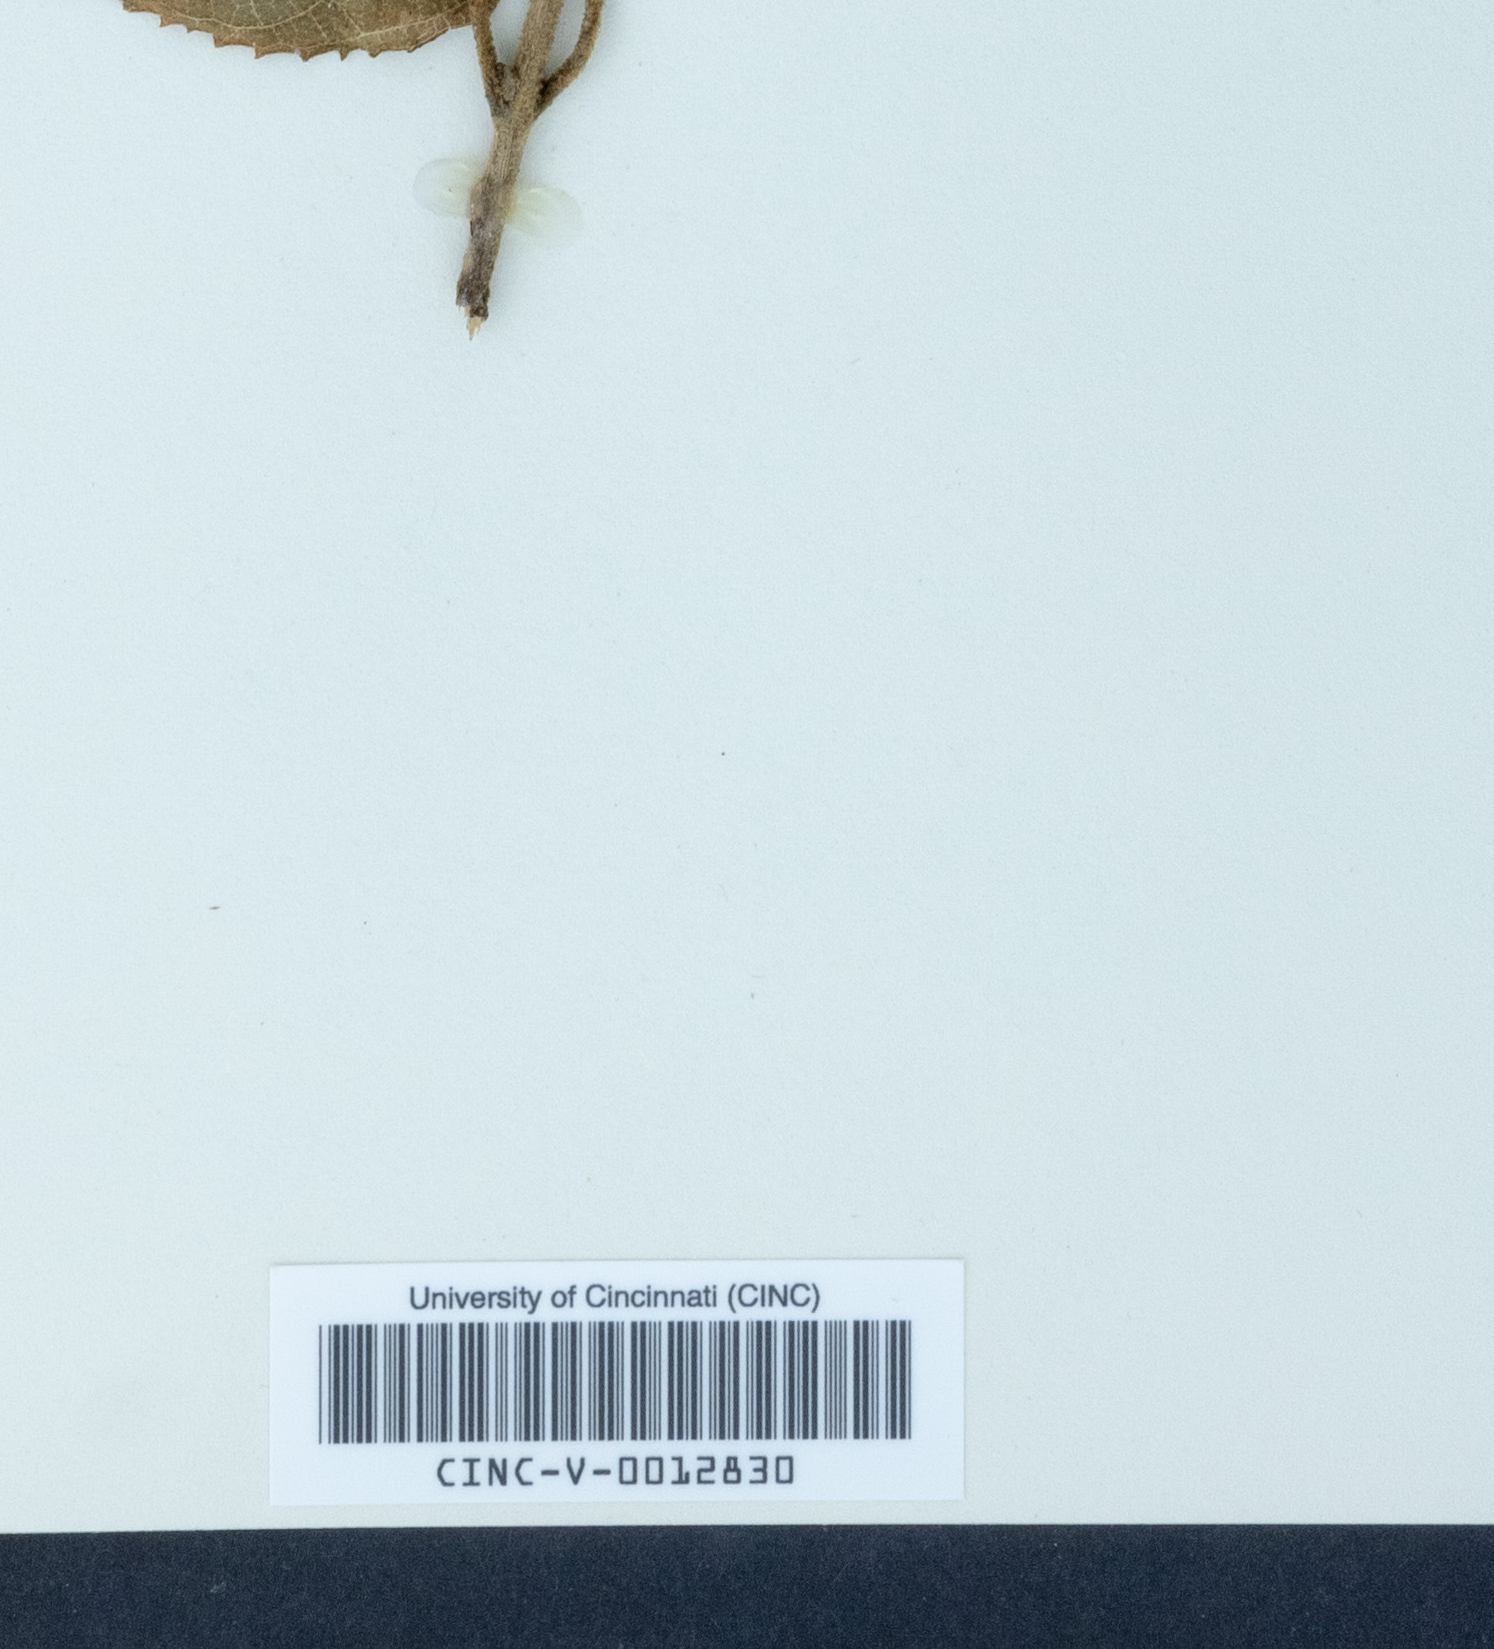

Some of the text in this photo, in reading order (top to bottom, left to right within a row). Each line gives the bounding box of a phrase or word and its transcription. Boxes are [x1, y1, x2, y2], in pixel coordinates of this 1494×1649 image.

[410, 1283, 820, 1315] University of Cincinnati (CINC)
[437, 1456, 794, 1487] CINC-V-0012830
